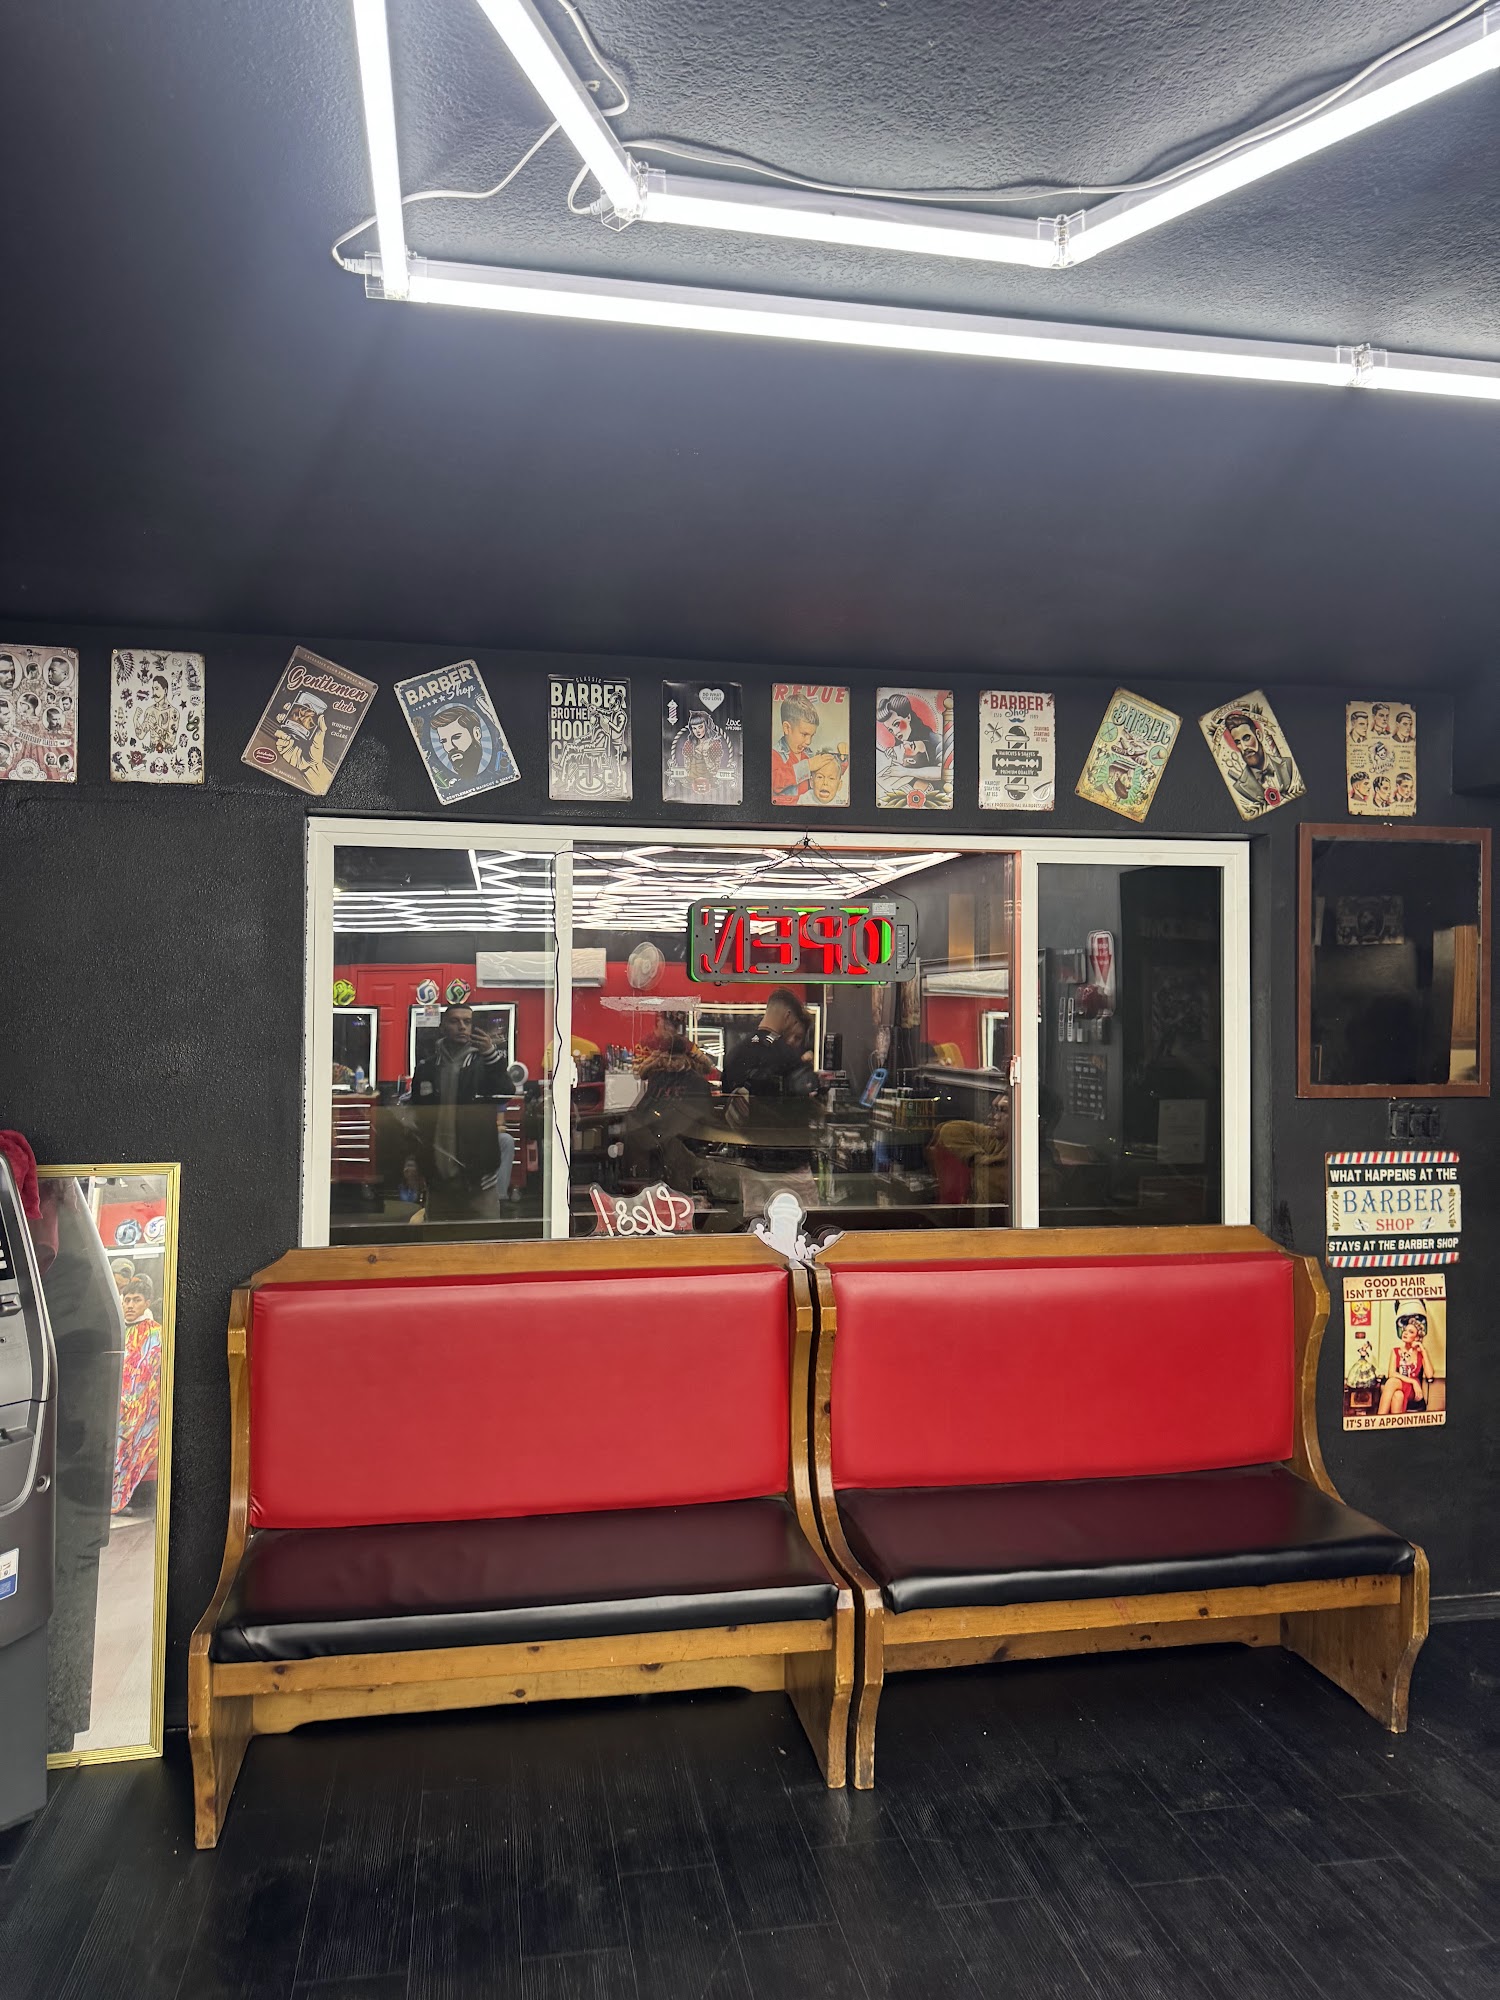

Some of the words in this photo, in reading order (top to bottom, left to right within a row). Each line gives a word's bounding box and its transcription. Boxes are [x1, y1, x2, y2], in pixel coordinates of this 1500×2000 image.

[287, 665, 368, 702] Gentlemen
[405, 667, 474, 706] BARBER
[446, 682, 476, 700] Shop
[550, 682, 627, 708] BARBER
[773, 684, 846, 704] REVUE
[990, 694, 1044, 711] BARBER
[1005, 705, 1029, 718] Shop
[1112, 702, 1171, 745] BARBER
[1330, 1169, 1362, 1182] WHAT
[1365, 1168, 1416, 1182] HAPPENS
[1419, 1168, 1433, 1181] AT
[1438, 1168, 1457, 1180] THE
[1343, 1188, 1444, 1214] BARBER
[1376, 1218, 1414, 1232] SHOP
[1329, 1240, 1361, 1252] STAYS
[1363, 1240, 1376, 1251] AT
[1378, 1240, 1396, 1250] THE
[1398, 1238, 1434, 1250] BARBER
[1437, 1237, 1459, 1248] SHOP
[1364, 1278, 1397, 1288] GOOD
[1400, 1276, 1426, 1287] HAIR
[1346, 1289, 1373, 1299] ISN'T
[1376, 1288, 1389, 1298] BY
[1393, 1286, 1444, 1297] ACCIDENT
[1346, 1418, 1362, 1428] IT'S
[1364, 1418, 1377, 1428] BY
[1379, 1414, 1444, 1426] APPOINTMENT
